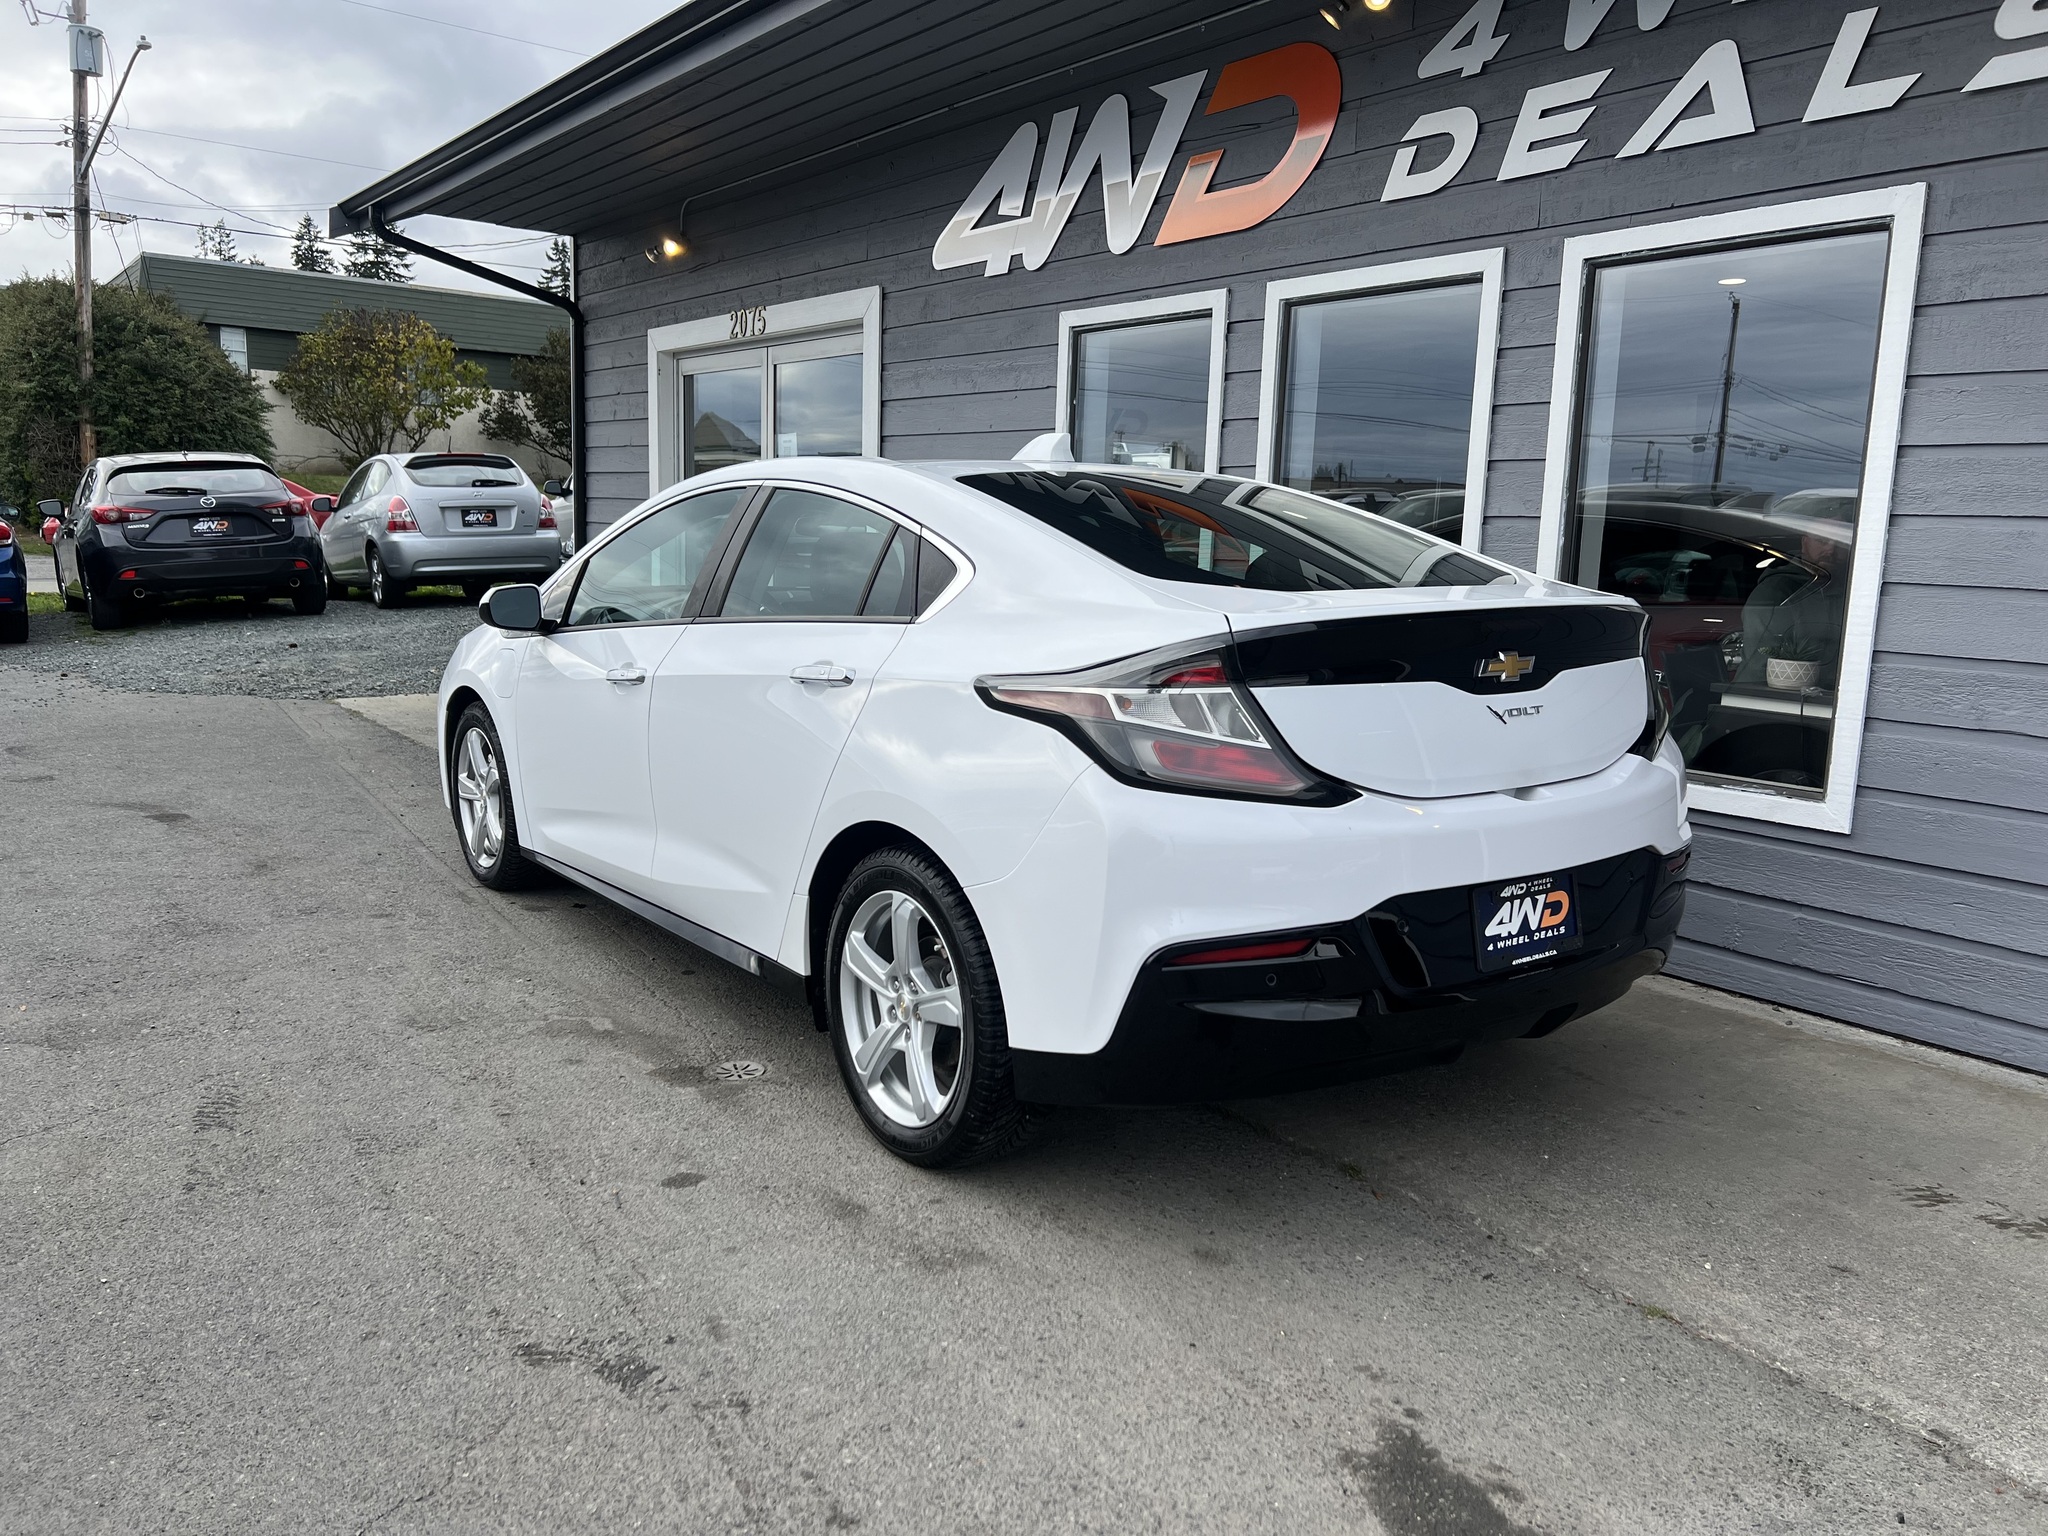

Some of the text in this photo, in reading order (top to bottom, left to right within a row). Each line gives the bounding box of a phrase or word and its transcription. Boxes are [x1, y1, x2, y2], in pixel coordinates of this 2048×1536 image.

[1417, 0, 1511, 79] 4
[932, 42, 1342, 277] 4WD
[730, 305, 767, 339] 2075
[192, 520, 229, 530] 4WD
[464, 513, 494, 521] 4WD
[1486, 704, 1544, 725] VOLT
[1500, 882, 1527, 898] 4WD
[1530, 882, 1551, 892] DEALS
[1533, 877, 1553, 886] WHEEL
[1484, 890, 1570, 938] 4WD
[1487, 926, 1566, 951] 4 WHEEL DEALS
